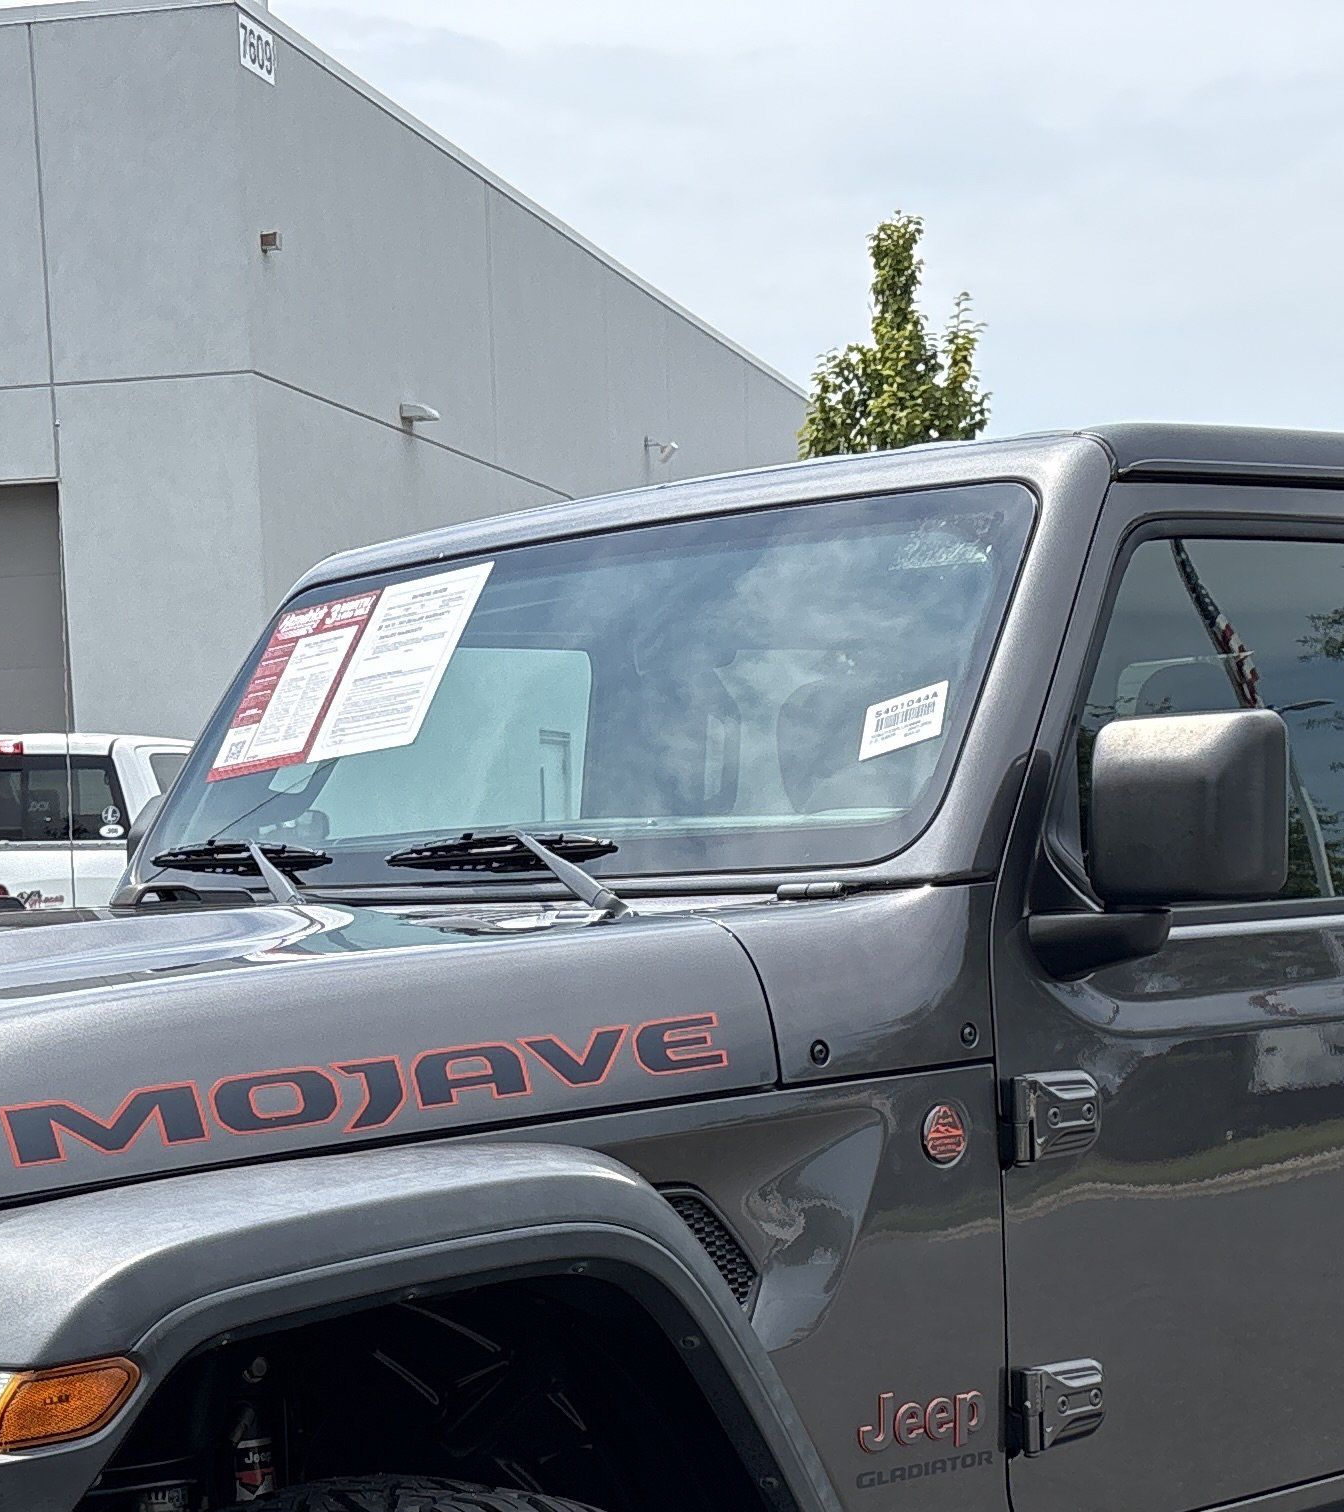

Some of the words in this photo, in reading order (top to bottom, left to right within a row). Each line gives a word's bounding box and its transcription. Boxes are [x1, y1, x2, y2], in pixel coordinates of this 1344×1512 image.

[240, 22, 273, 75] 7609
[858, 1390, 987, 1454] Jeep
[856, 1451, 994, 1489] GLADIATOR
